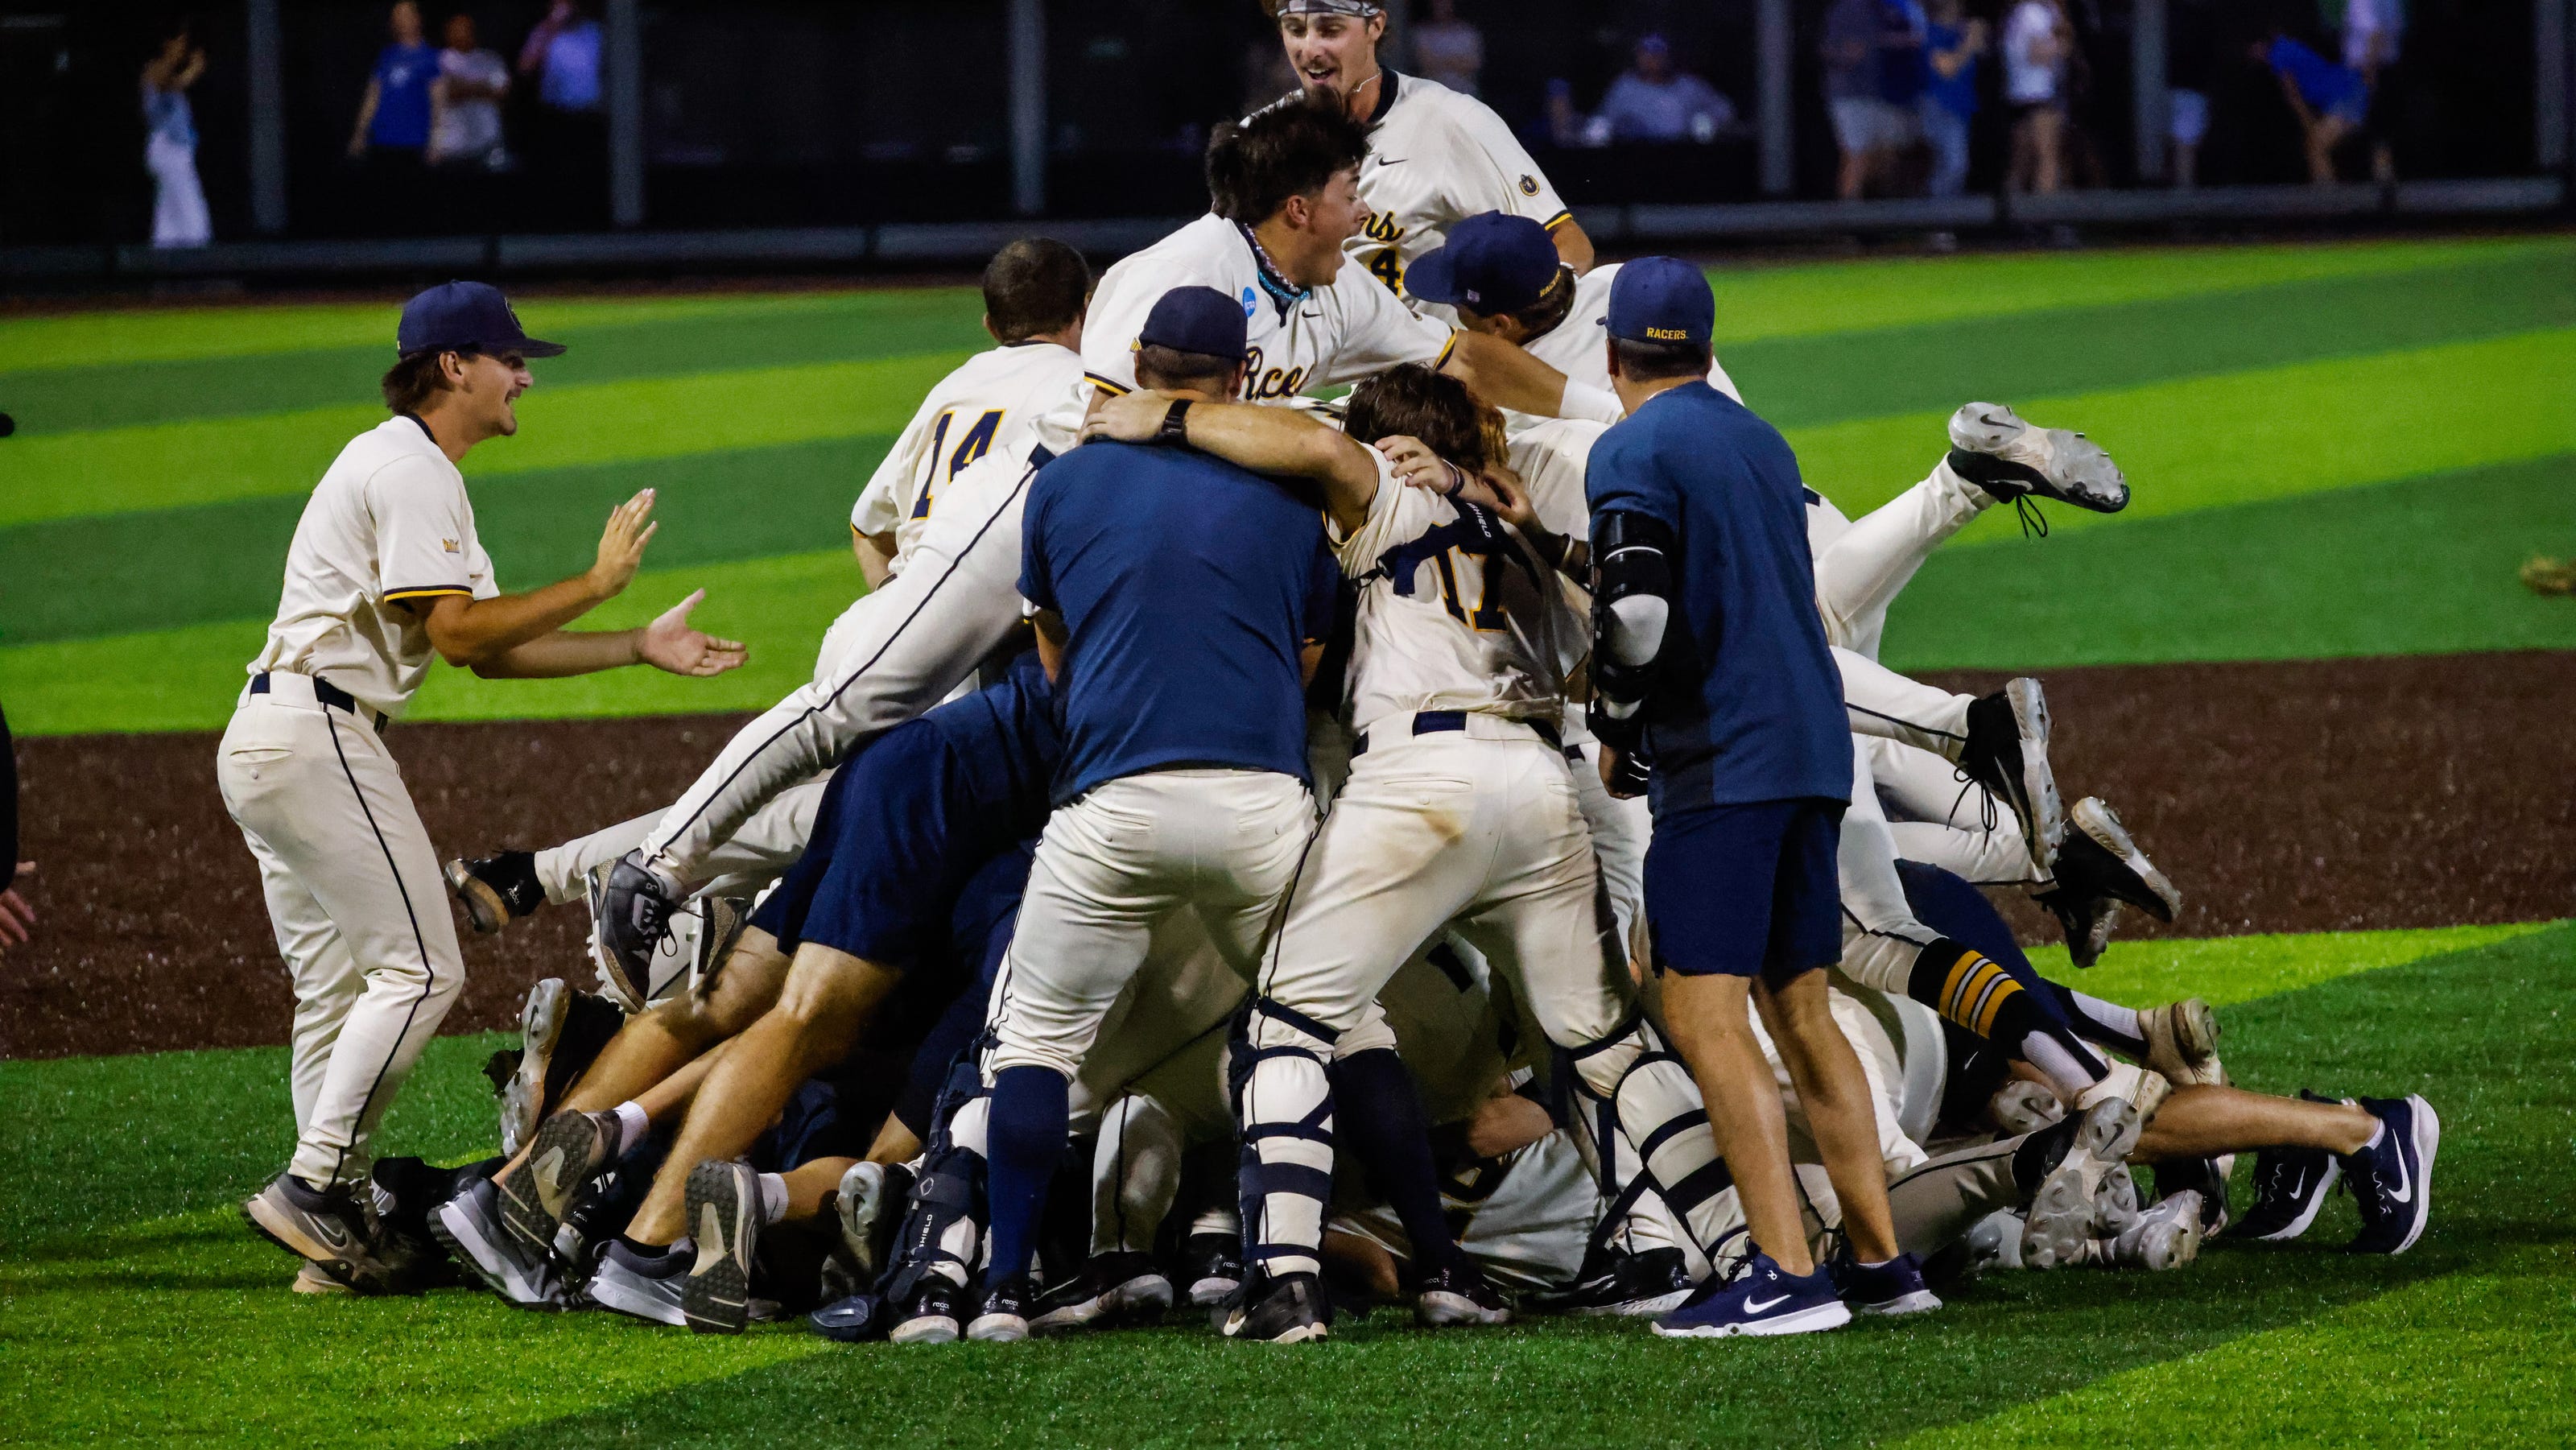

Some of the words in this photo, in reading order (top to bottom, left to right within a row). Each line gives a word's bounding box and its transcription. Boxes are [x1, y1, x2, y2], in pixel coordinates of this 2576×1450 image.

[1646, 327, 1687, 341] RACERS
[910, 408, 1006, 521] 14
[1466, 502, 1492, 538] SHIELD
[919, 1214, 933, 1248] SHIELD
